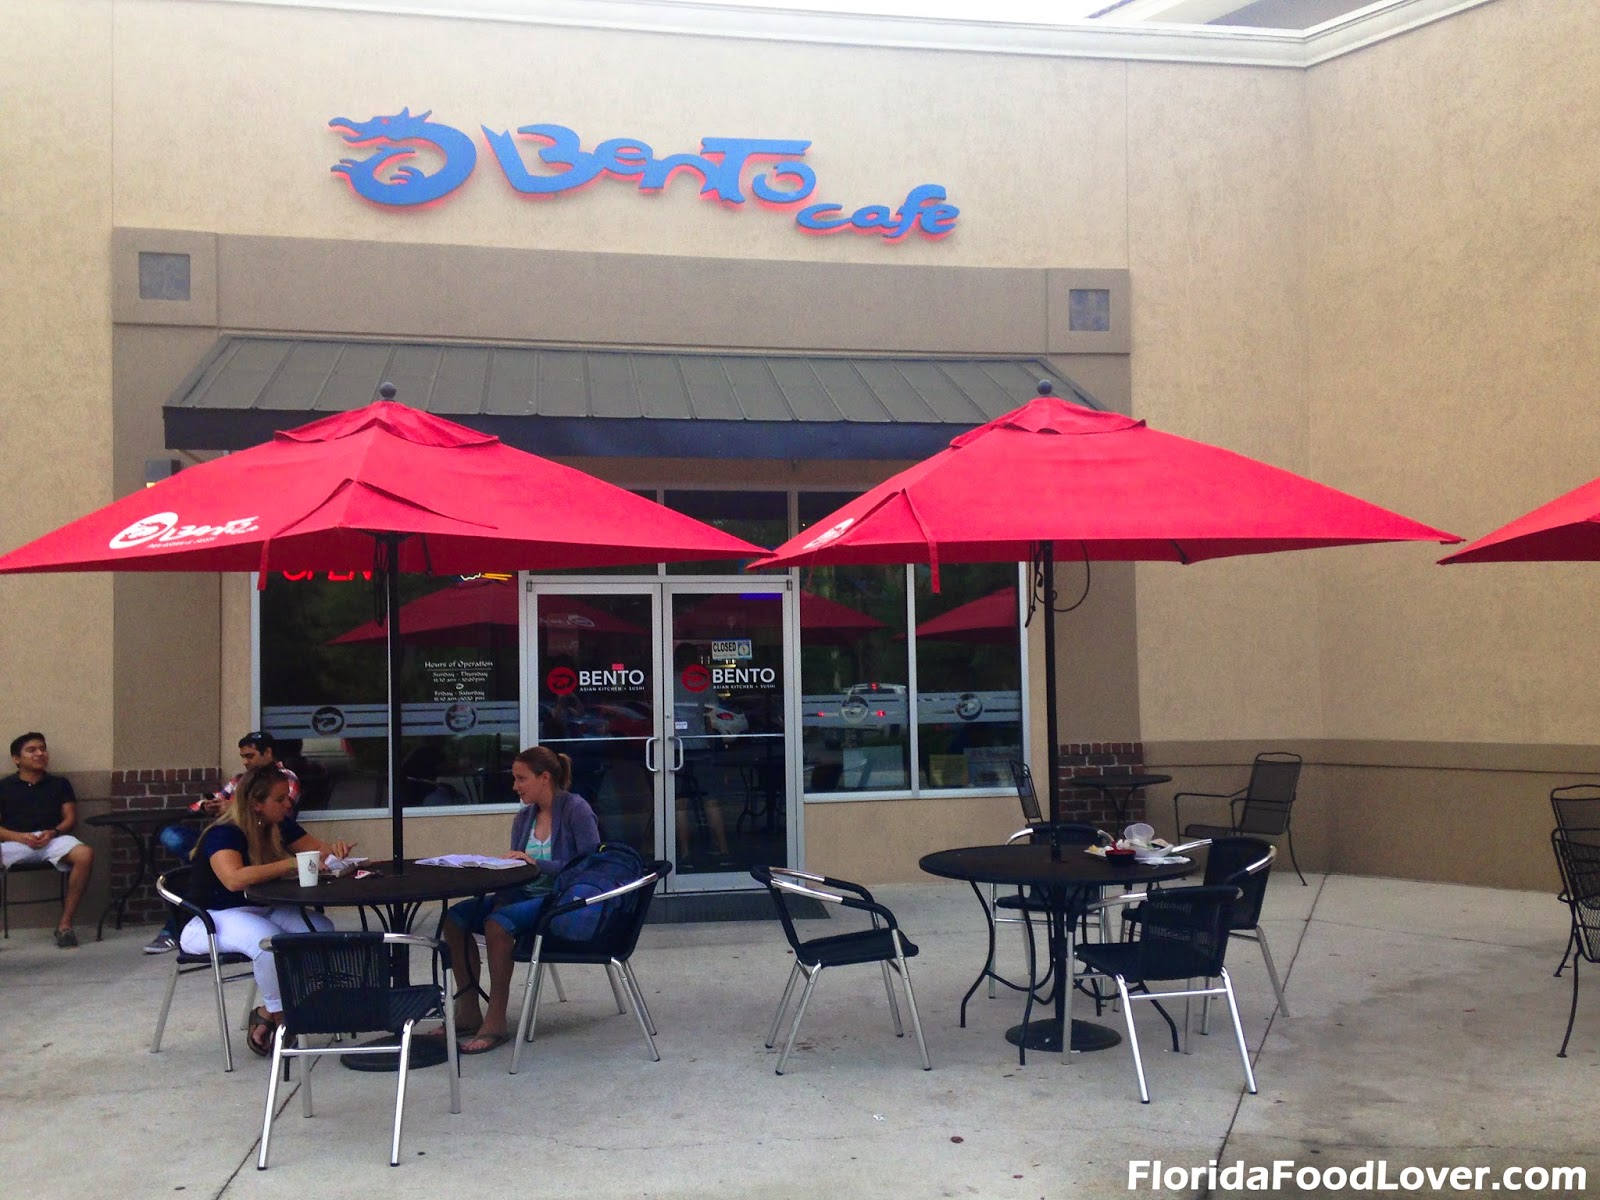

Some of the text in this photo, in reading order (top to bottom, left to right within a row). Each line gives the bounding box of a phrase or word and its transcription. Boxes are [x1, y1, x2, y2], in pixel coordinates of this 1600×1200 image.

[713, 641, 737, 652] CLOSED
[448, 660, 457, 668] of
[457, 660, 493, 668] Operation
[579, 669, 645, 686] BENTO
[712, 667, 776, 684] BENTO
